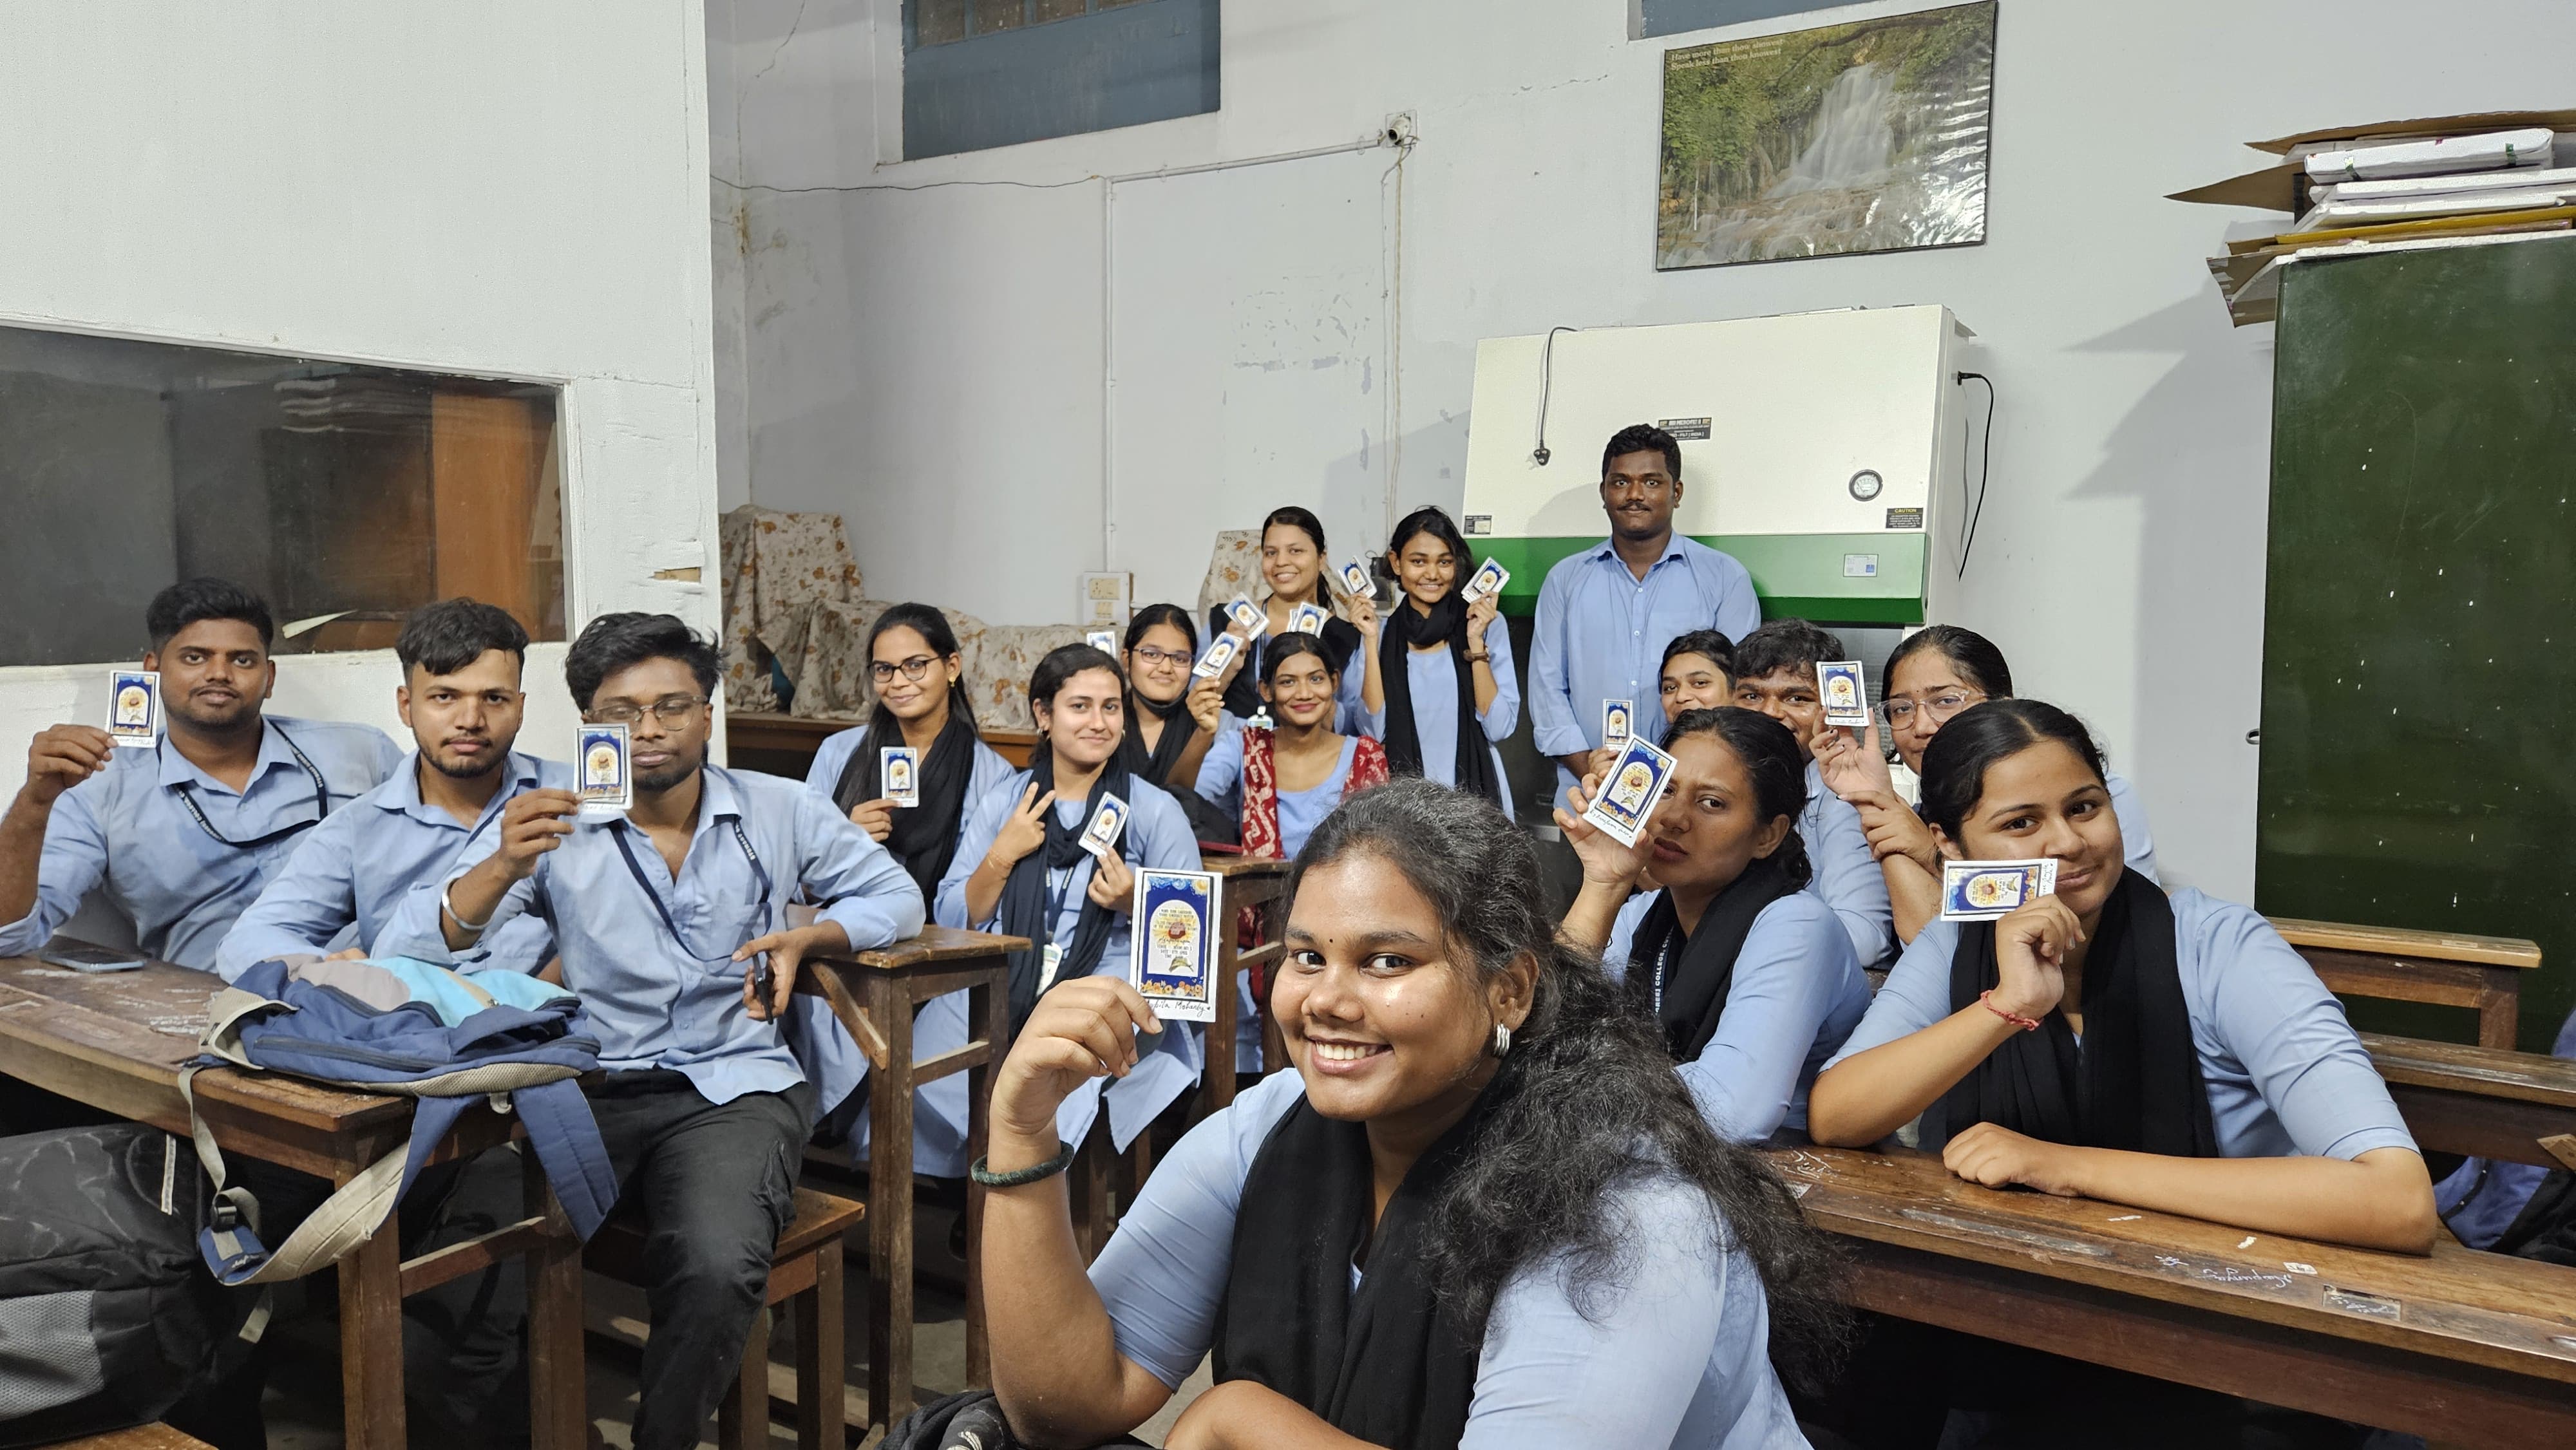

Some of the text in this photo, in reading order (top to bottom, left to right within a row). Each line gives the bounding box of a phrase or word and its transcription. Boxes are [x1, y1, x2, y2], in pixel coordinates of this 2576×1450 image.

[1671, 39, 1784, 61] Have more than thou showest
[1671, 61, 1694, 71] Speak
[1712, 56, 1729, 64] than
[1730, 53, 1748, 61] thou
[1750, 48, 1782, 58] knowest
